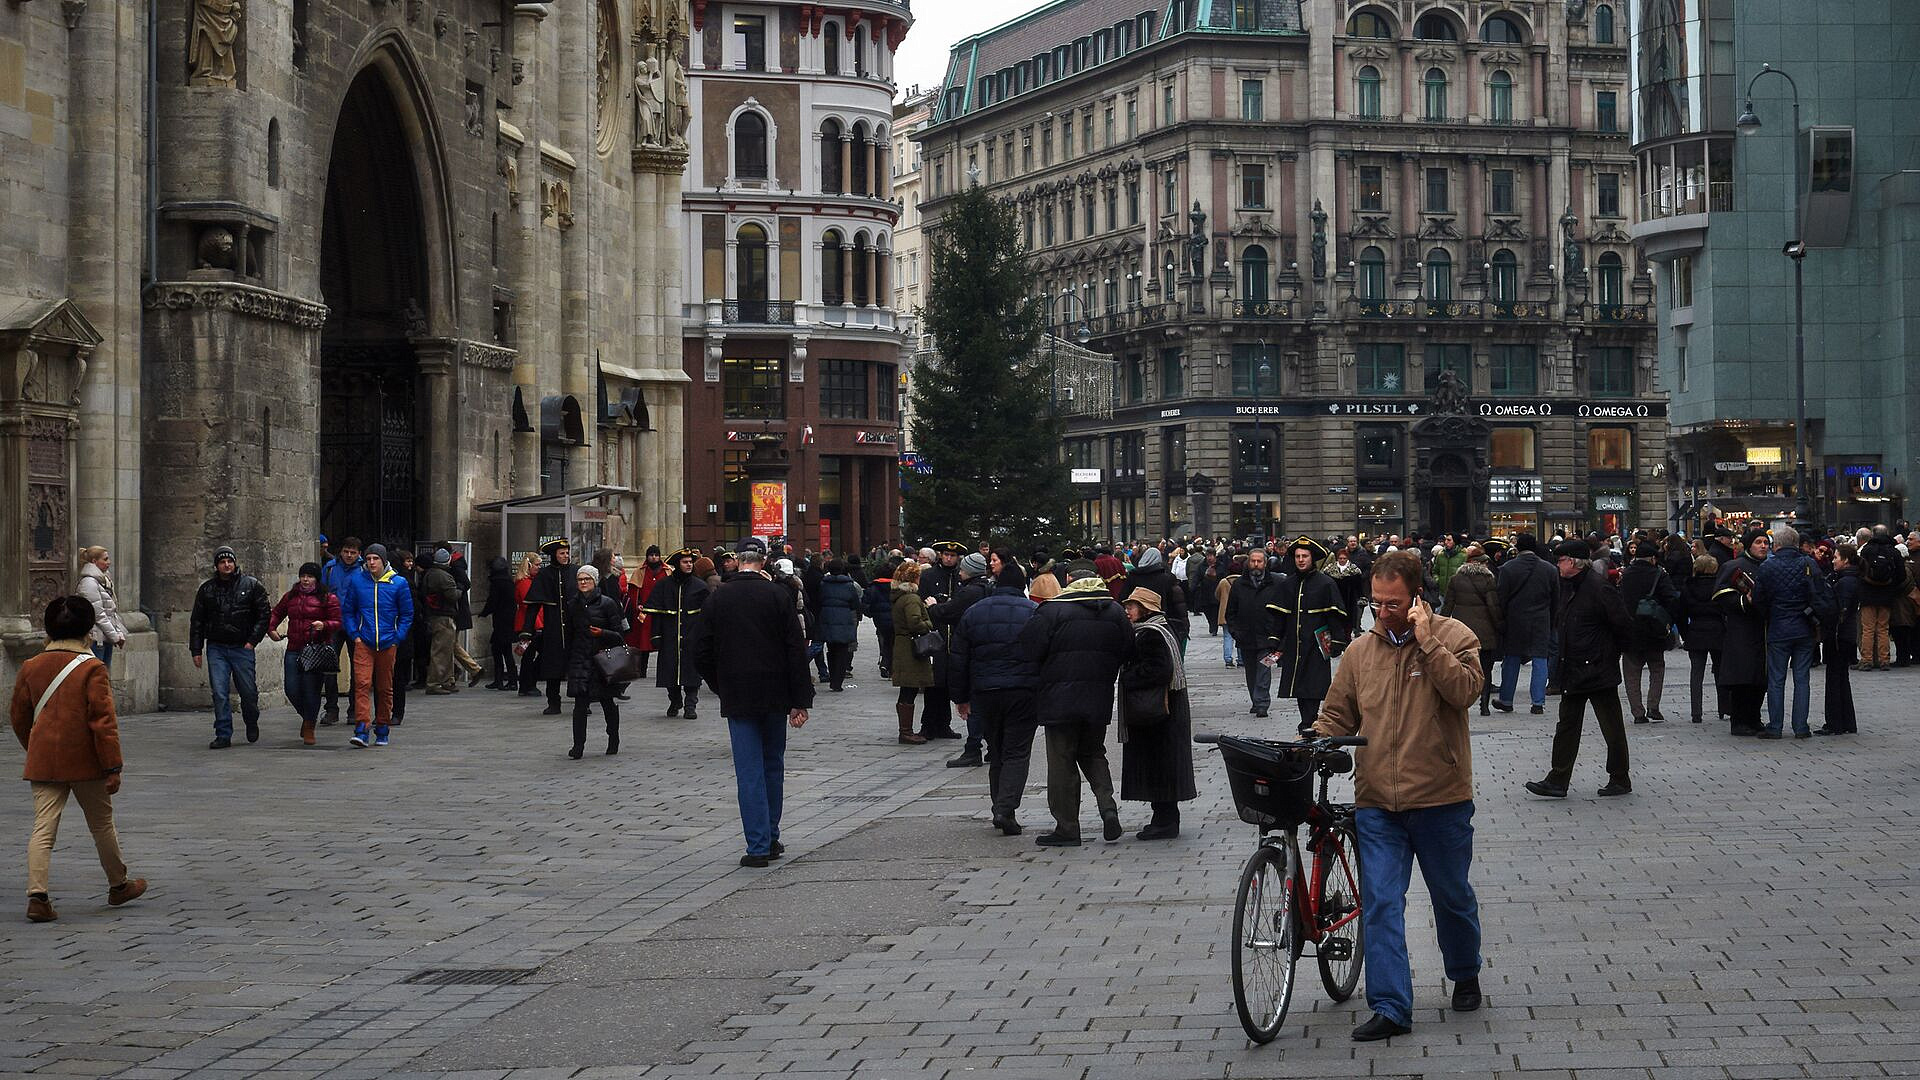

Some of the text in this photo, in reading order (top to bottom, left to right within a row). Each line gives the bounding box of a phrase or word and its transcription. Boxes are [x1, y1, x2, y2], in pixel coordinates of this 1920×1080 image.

[1345, 404, 1402, 414] PILSTL
[1494, 405, 1536, 416] OMEGA
[1593, 406, 1633, 417] OMEGA
[763, 486, 772, 496] 27
